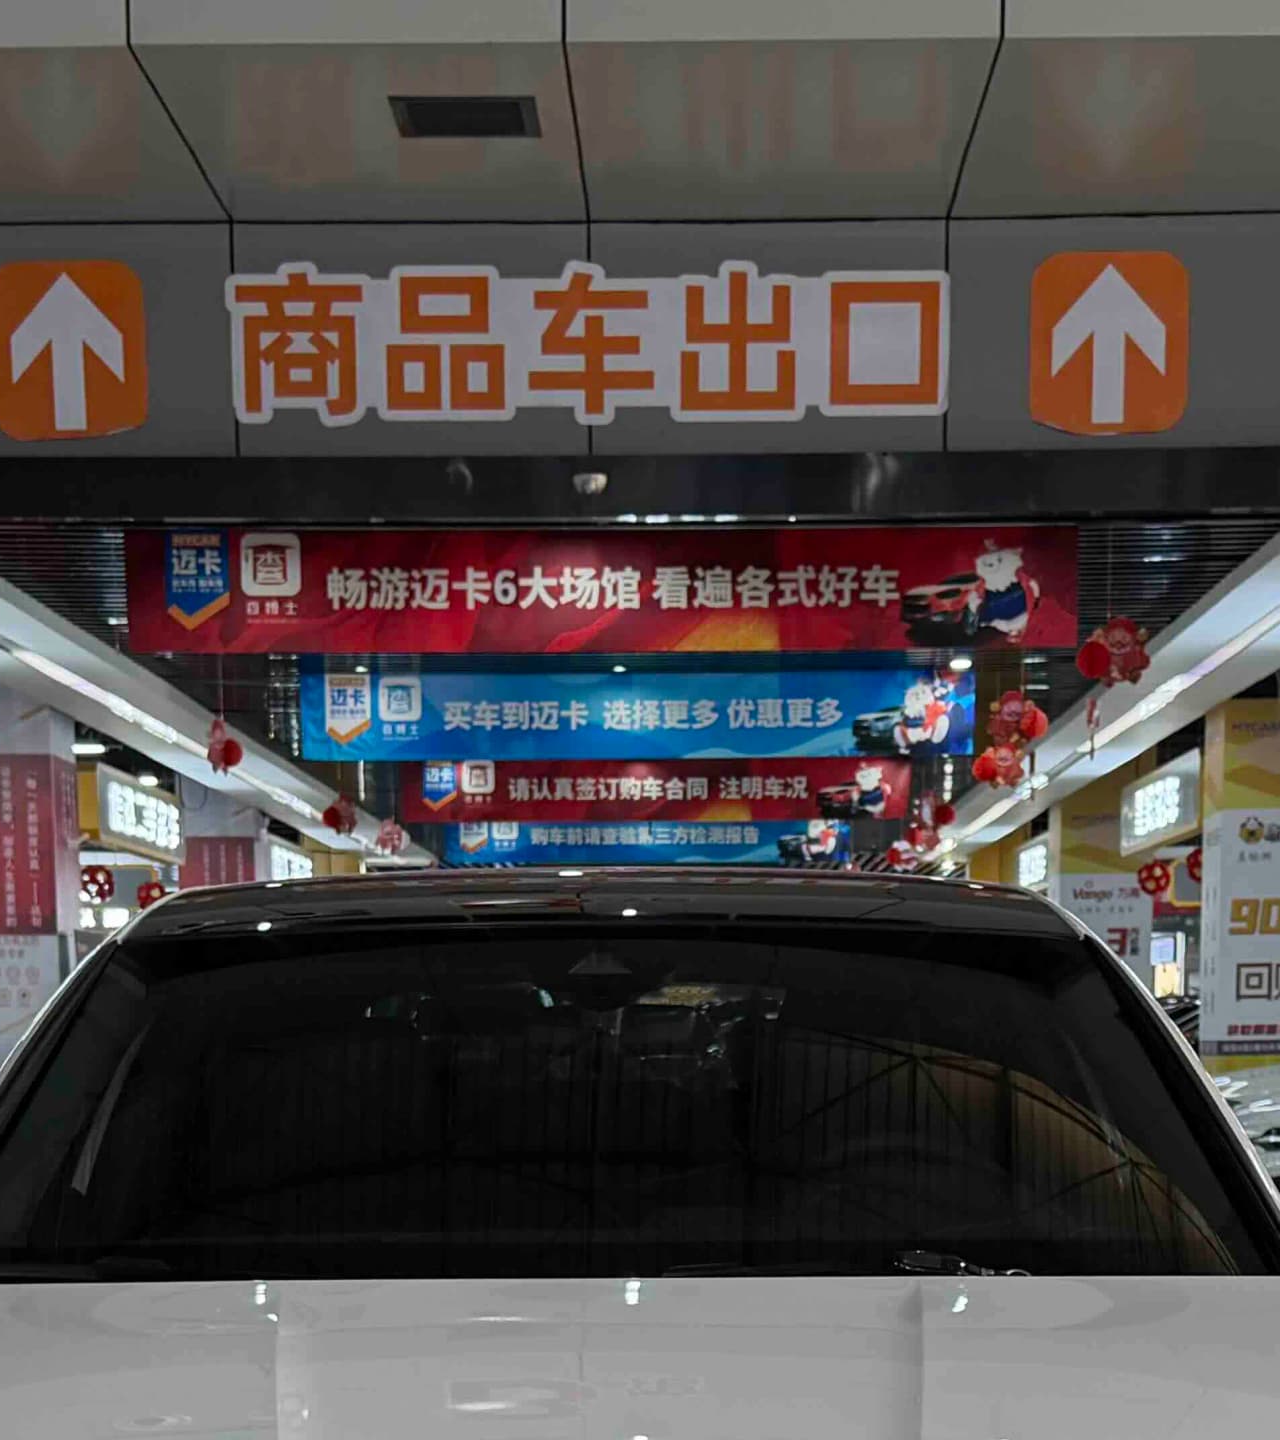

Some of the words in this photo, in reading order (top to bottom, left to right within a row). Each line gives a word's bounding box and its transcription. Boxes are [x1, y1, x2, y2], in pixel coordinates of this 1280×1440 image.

[232, 270, 942, 416] 商品车出口
[172, 548, 222, 575] 迈卡
[326, 566, 641, 611] 畅游迈卡6大场馆
[652, 565, 902, 610] 看遍各式好车
[443, 700, 589, 731] 买车到迈卡
[602, 699, 719, 731] 选择更多
[727, 698, 843, 730] 优惠更多
[508, 777, 709, 801] 请认真签订购车合同
[719, 776, 809, 800] 注明车况
